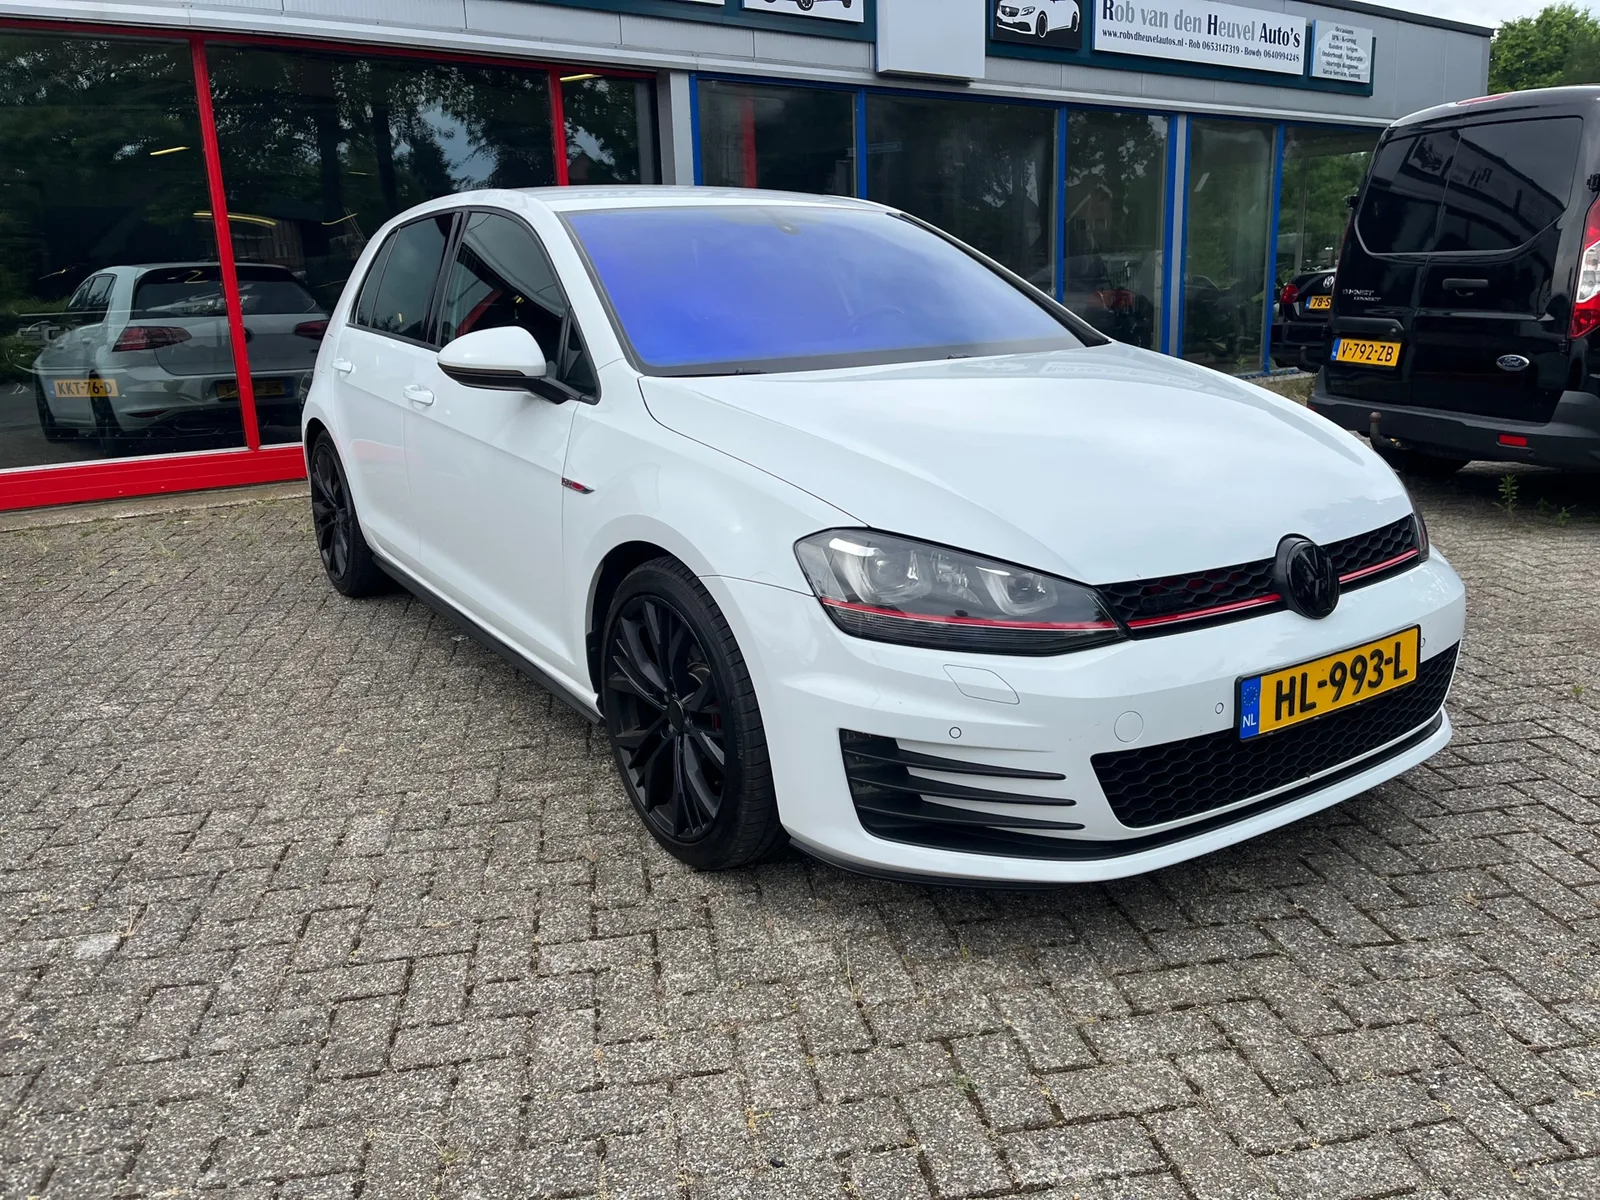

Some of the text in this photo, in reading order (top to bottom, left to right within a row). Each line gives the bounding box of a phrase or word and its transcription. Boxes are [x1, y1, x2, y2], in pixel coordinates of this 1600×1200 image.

[1102, 0, 1300, 48] Rob van den Heuvel Auto's
[1188, 39, 1201, 49] Rob
[1341, 342, 1394, 362] V-792-ZB
[57, 381, 113, 395] KKT-76-D
[1274, 641, 1408, 722] HL-993-L
[1242, 713, 1257, 728] NL
